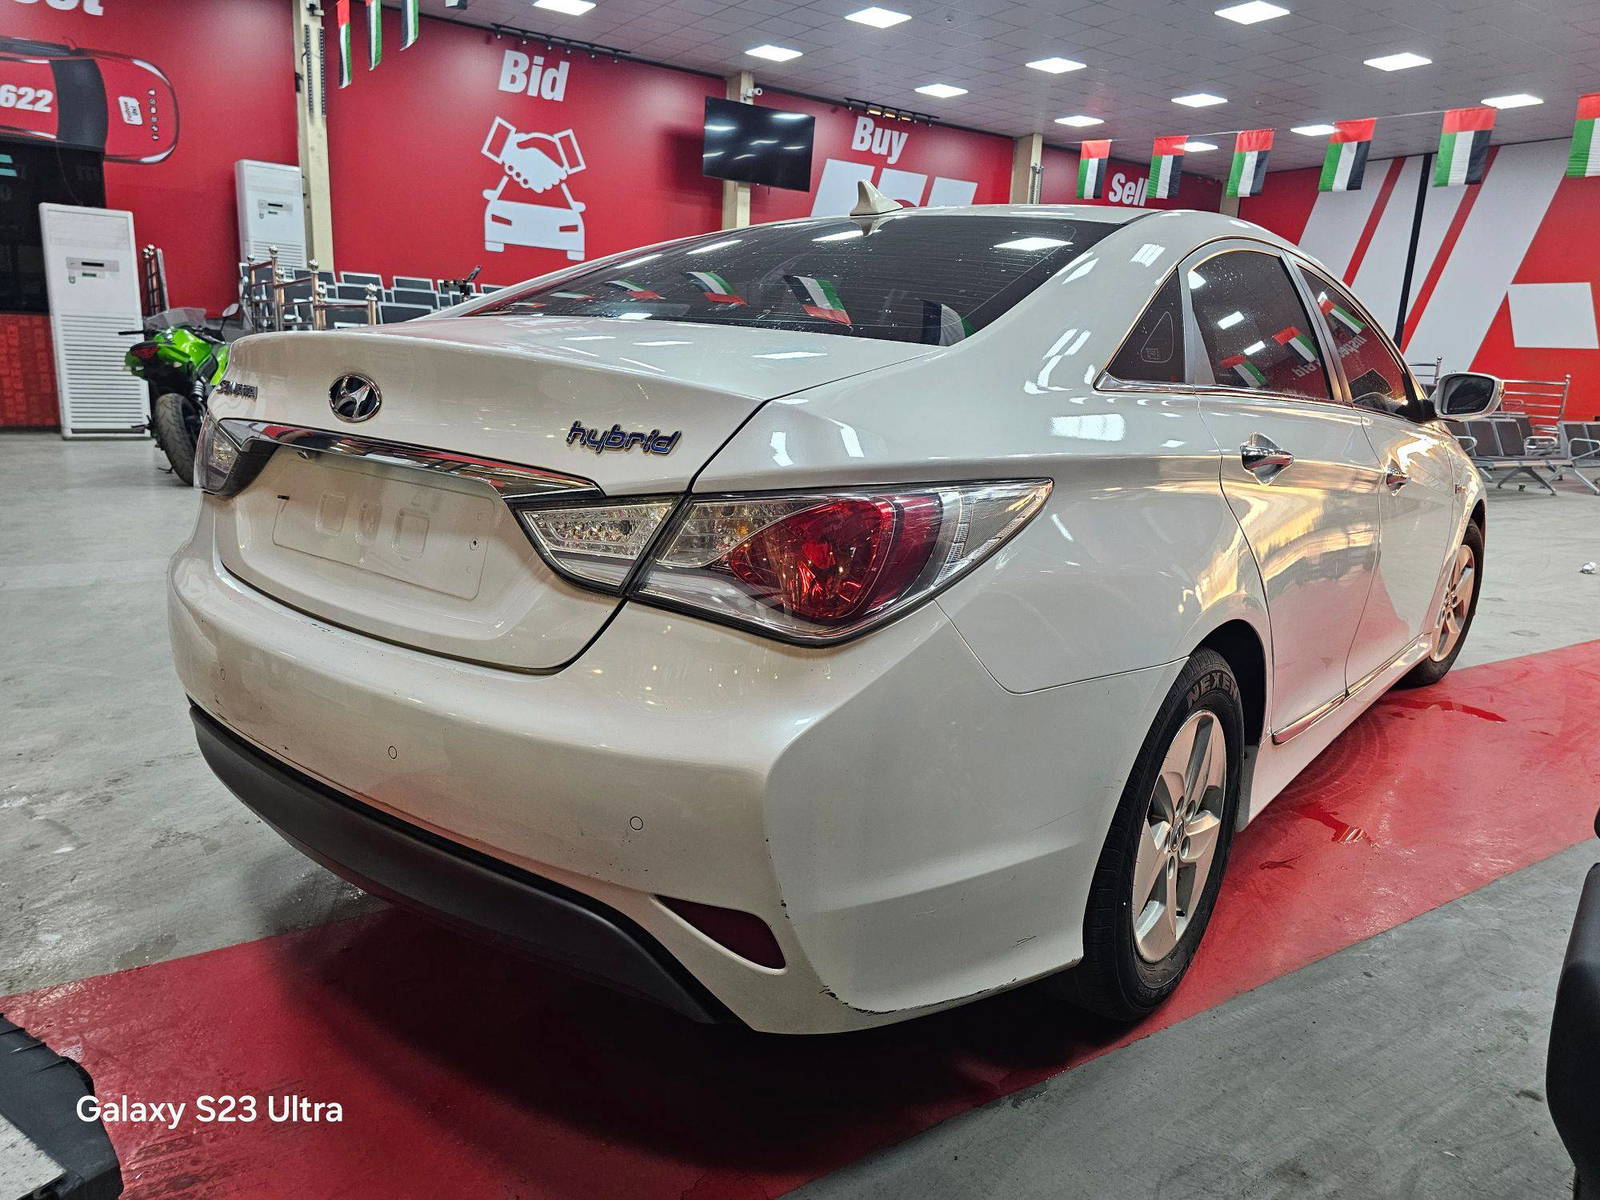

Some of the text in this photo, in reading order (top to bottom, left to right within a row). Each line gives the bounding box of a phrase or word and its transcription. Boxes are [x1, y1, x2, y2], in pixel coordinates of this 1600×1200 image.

[498, 49, 570, 102] Bid
[0, 84, 53, 112] 622
[851, 116, 909, 164] Buy
[1108, 172, 1149, 206] Sell
[566, 420, 682, 455] hybrid
[1186, 671, 1241, 711] NEXEN
